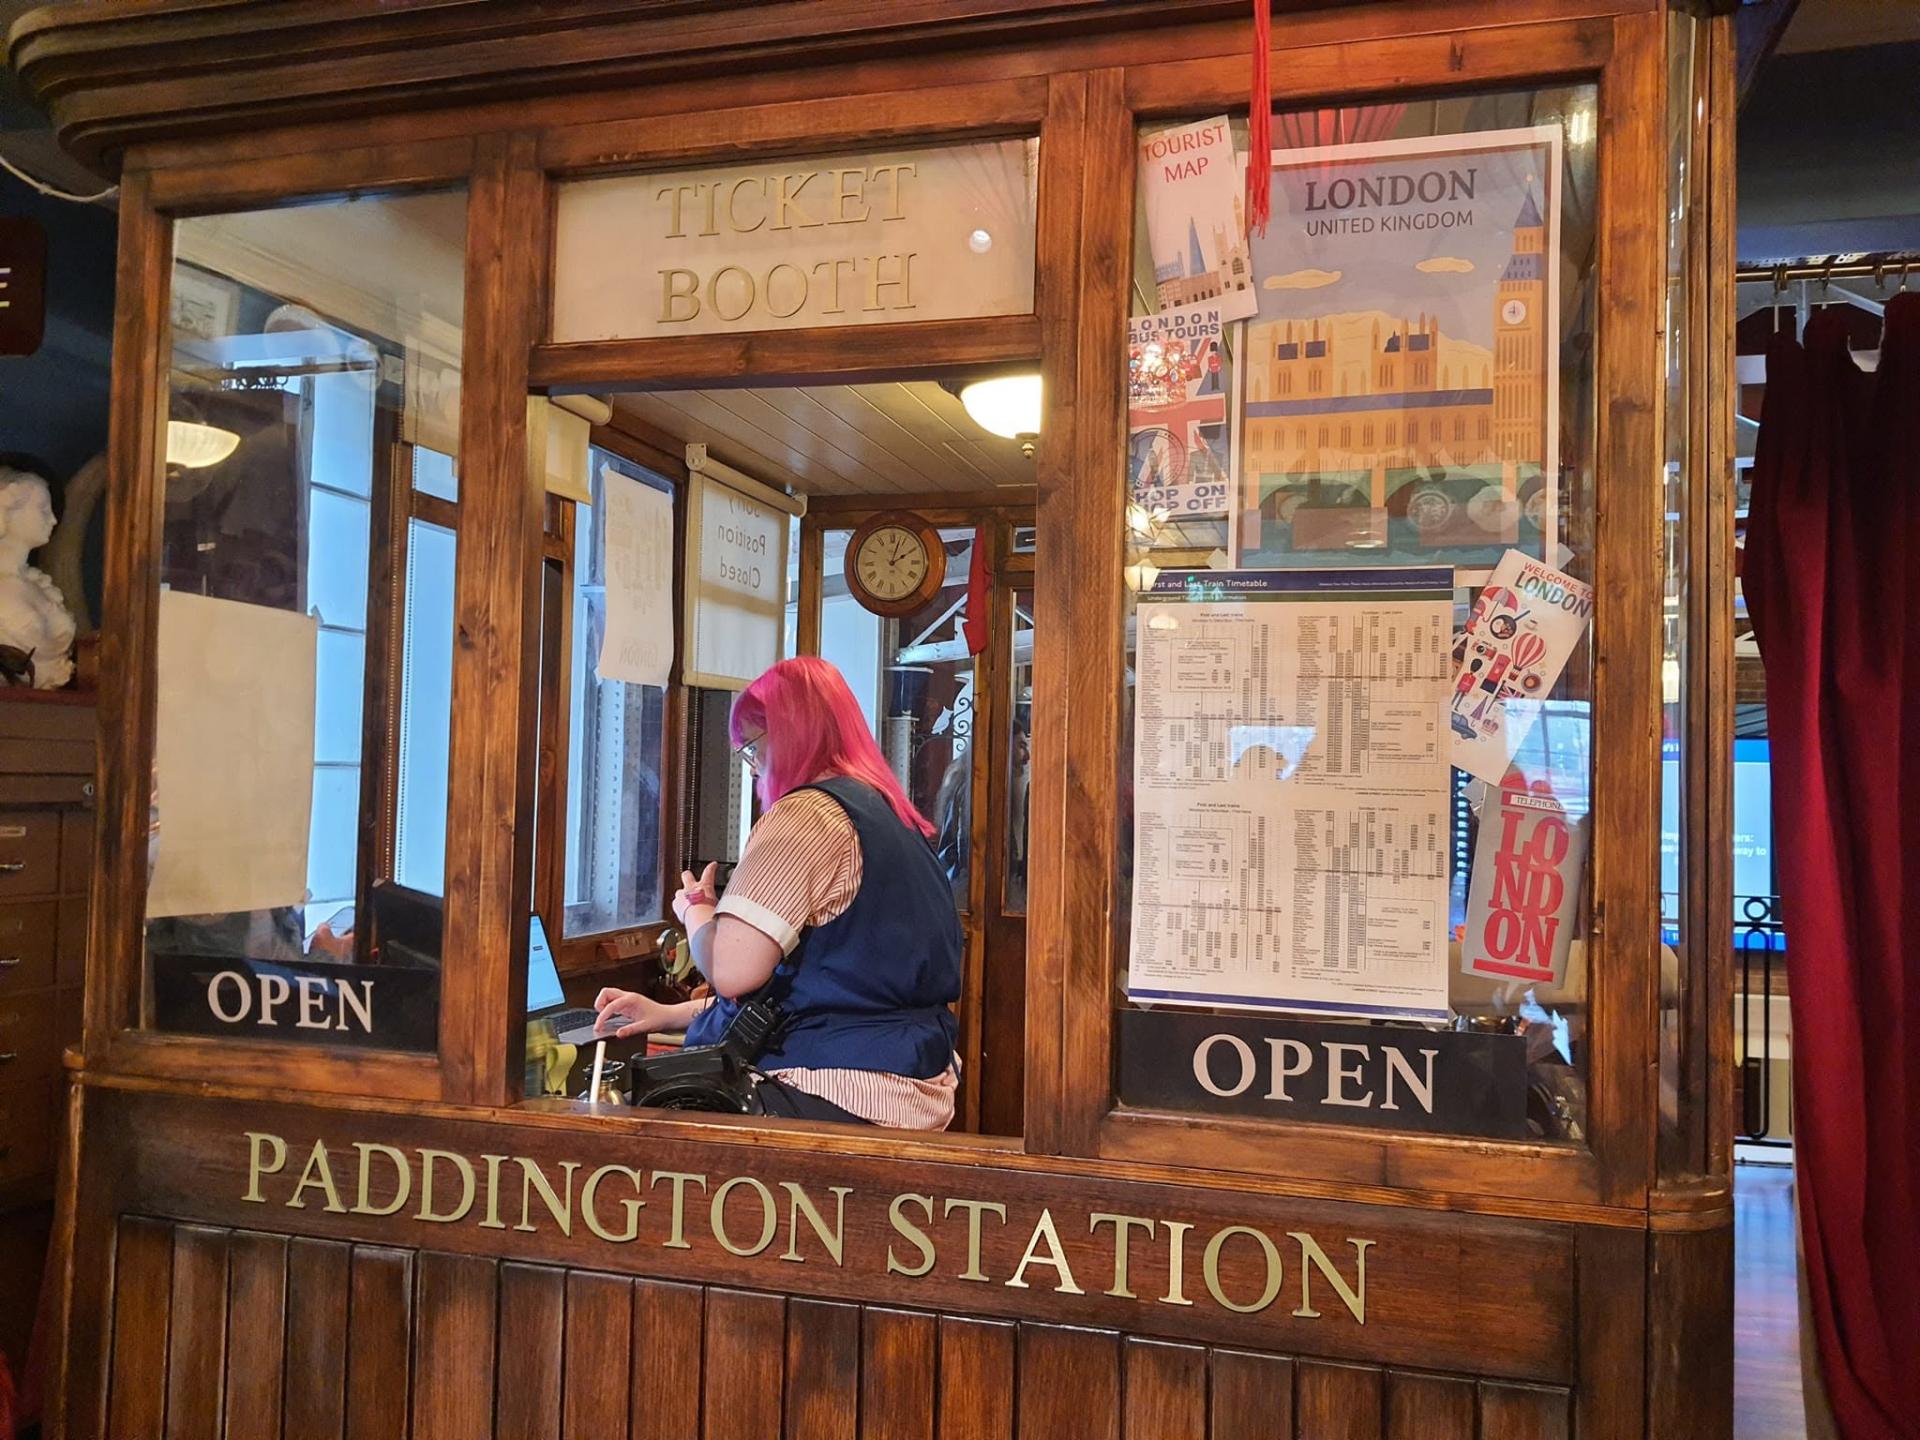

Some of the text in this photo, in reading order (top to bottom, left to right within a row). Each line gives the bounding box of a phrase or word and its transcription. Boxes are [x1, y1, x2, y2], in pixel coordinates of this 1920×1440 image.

[1143, 124, 1225, 162] TOURIST
[1164, 157, 1208, 183] MAP
[656, 163, 917, 238] TICKET
[1305, 168, 1477, 211] LONDON
[1307, 210, 1473, 237] UNITED KINGDOM
[657, 253, 917, 323] BOOTH
[1128, 311, 1219, 332] LONDON
[1128, 323, 1219, 345] BUS TOURS
[1135, 485, 1225, 503] HOP ON
[1186, 497, 1227, 511] OFF
[1167, 580, 1182, 588] and
[1204, 580, 1224, 588] Train
[1227, 580, 1268, 588] Timetable
[1514, 571, 1592, 618] LONDON
[1524, 562, 1578, 593] WELCOME
[1755, 847, 1767, 856] to
[1483, 908, 1560, 968] ON
[207, 970, 375, 1033] OPEN
[1192, 1033, 1440, 1114] OPEN
[240, 1131, 1377, 1325] PADDINGTON STATION
